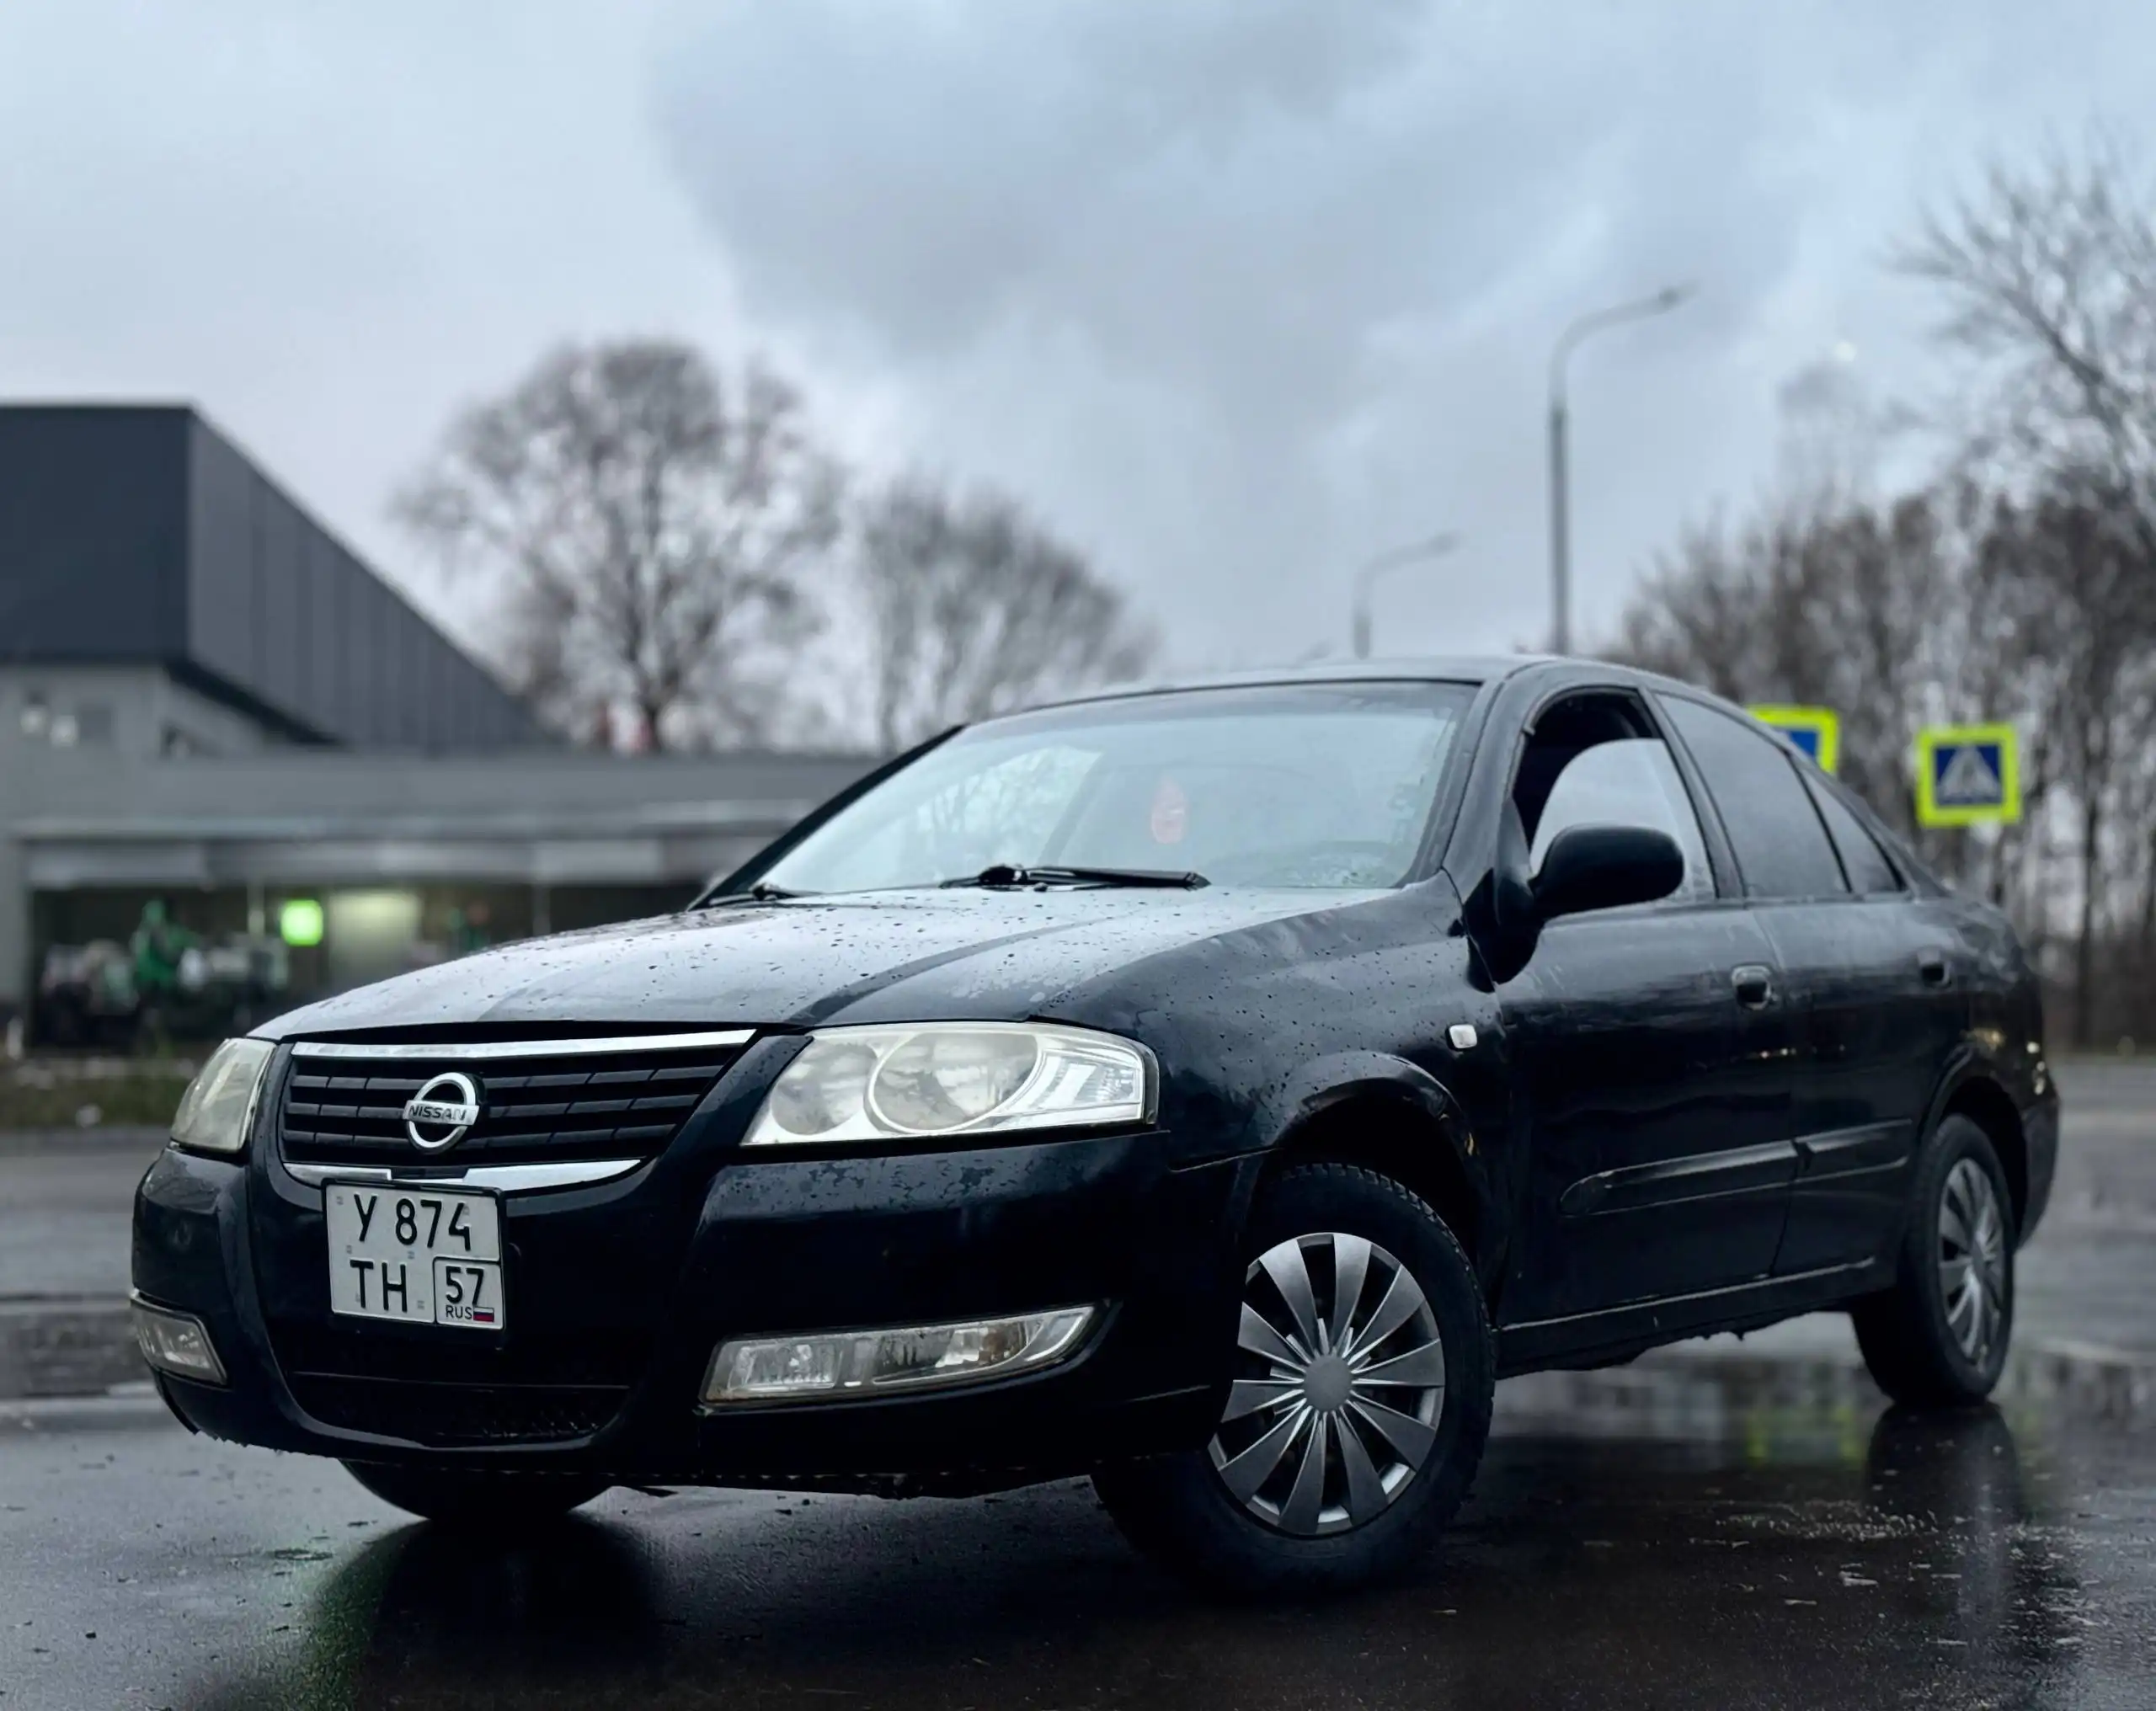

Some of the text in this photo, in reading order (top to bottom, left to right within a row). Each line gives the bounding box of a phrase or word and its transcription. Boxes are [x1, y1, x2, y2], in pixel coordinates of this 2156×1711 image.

[409, 1105, 467, 1121] NISSAN
[396, 1198, 471, 1251] 874
[446, 1266, 484, 1305] 57
[446, 1305, 472, 1319] RUS
